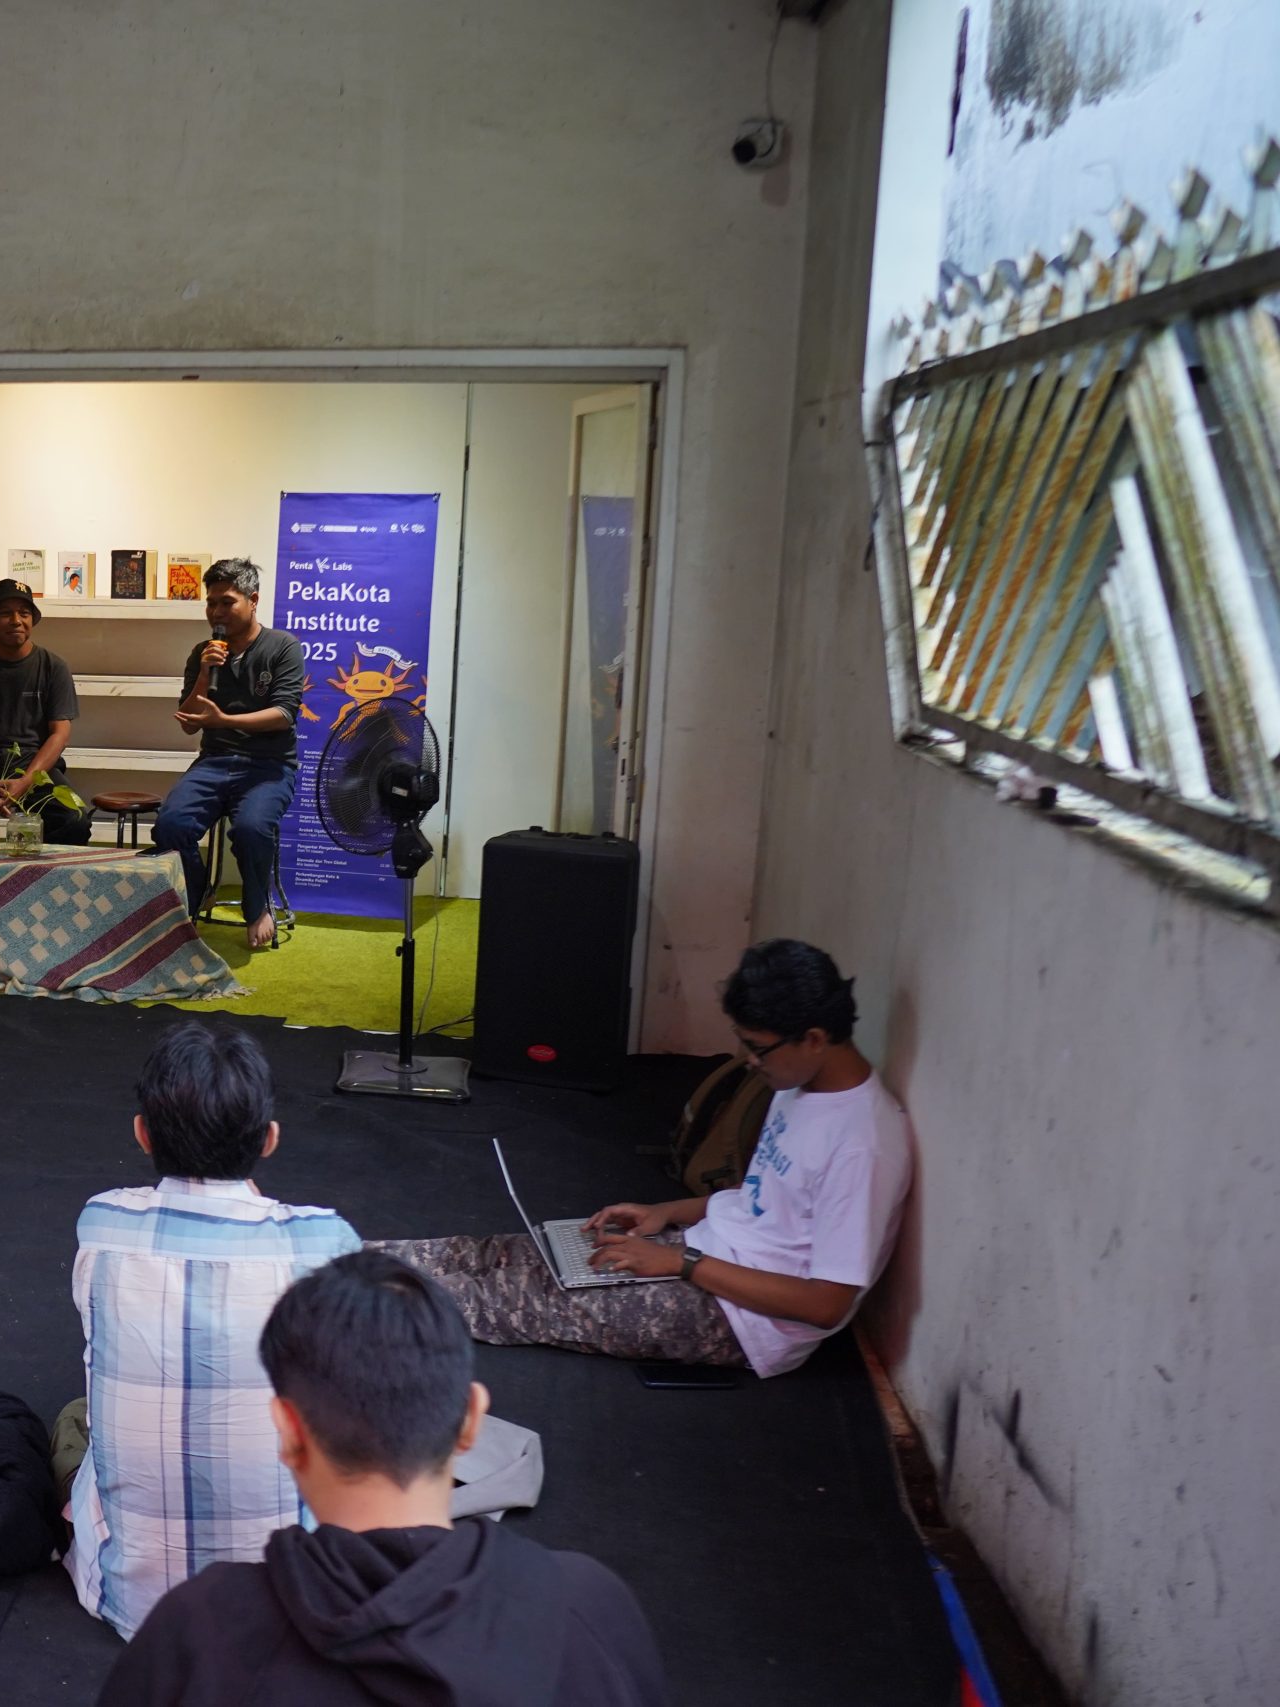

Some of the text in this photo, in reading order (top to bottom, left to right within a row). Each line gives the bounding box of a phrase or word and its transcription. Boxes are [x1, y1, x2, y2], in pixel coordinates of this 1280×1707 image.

[289, 561, 353, 571] Penta Labs
[288, 581, 391, 603] PekaKota
[285, 610, 380, 633] Institute
[300, 641, 338, 662] 025
